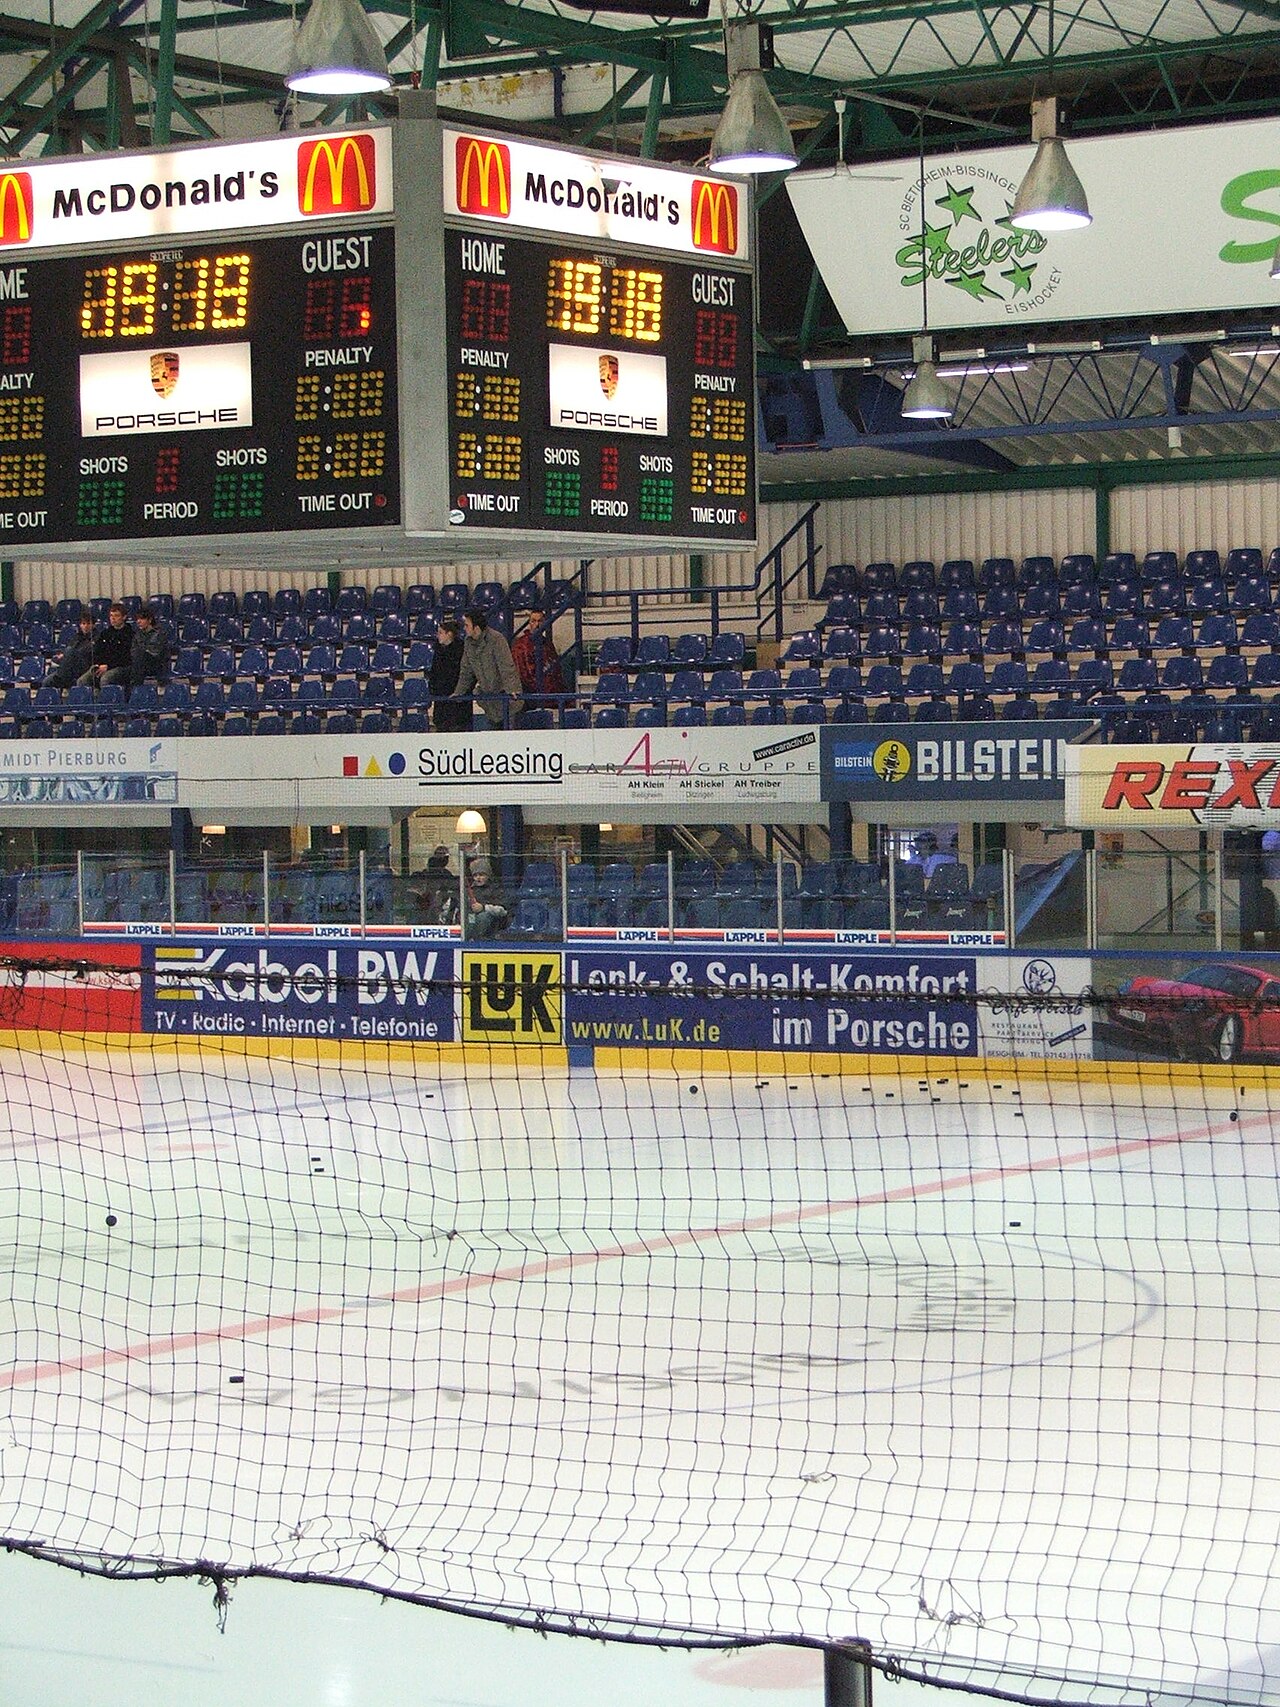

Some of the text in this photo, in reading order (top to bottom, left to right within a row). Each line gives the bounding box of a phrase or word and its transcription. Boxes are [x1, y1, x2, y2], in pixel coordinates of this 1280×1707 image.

[53, 171, 279, 218] McDonald's
[525, 172, 680, 226] McDonald's
[899, 165, 1019, 231] SC BIETIGHEIM-BISSINGE
[301, 236, 373, 273] GUEST
[461, 238, 506, 275] HOME
[895, 228, 1048, 287] Steelers
[691, 273, 737, 306] GUEST
[1005, 266, 1062, 314] EISHOCKEY
[305, 346, 373, 367] PENALTY
[461, 348, 509, 369] PENALTY
[694, 374, 736, 393] PENALTY
[96, 408, 238, 431] PORSCHE
[560, 410, 658, 431] PORSCHE
[79, 456, 128, 475] SHOTS
[216, 448, 268, 467] SHOTS
[544, 447, 580, 466] SHOTS
[639, 455, 673, 473] SHOTS
[144, 502, 199, 520] PERIOD
[299, 493, 373, 512] TIME OUT
[467, 493, 520, 513] TIME OUT
[590, 499, 628, 517] PERIOD
[17, 511, 47, 528] OUT
[691, 507, 737, 525] TIME OUT
[418, 747, 563, 777] SüdLeasing
[698, 762, 817, 772] GRUPPE
[835, 757, 873, 767] BILSTEIN
[643, 780, 664, 788] Klein
[694, 780, 724, 788] Stickel
[750, 780, 781, 788] Treiber
[1101, 760, 1280, 809] REX
[155, 948, 438, 1005] Kabel BW
[668, 961, 693, 999] &
[155, 1011, 438, 1038] TV Radio Internet Telefonie
[572, 1018, 721, 1042] www.LuK.de
[772, 1007, 970, 1050] im Porsche
